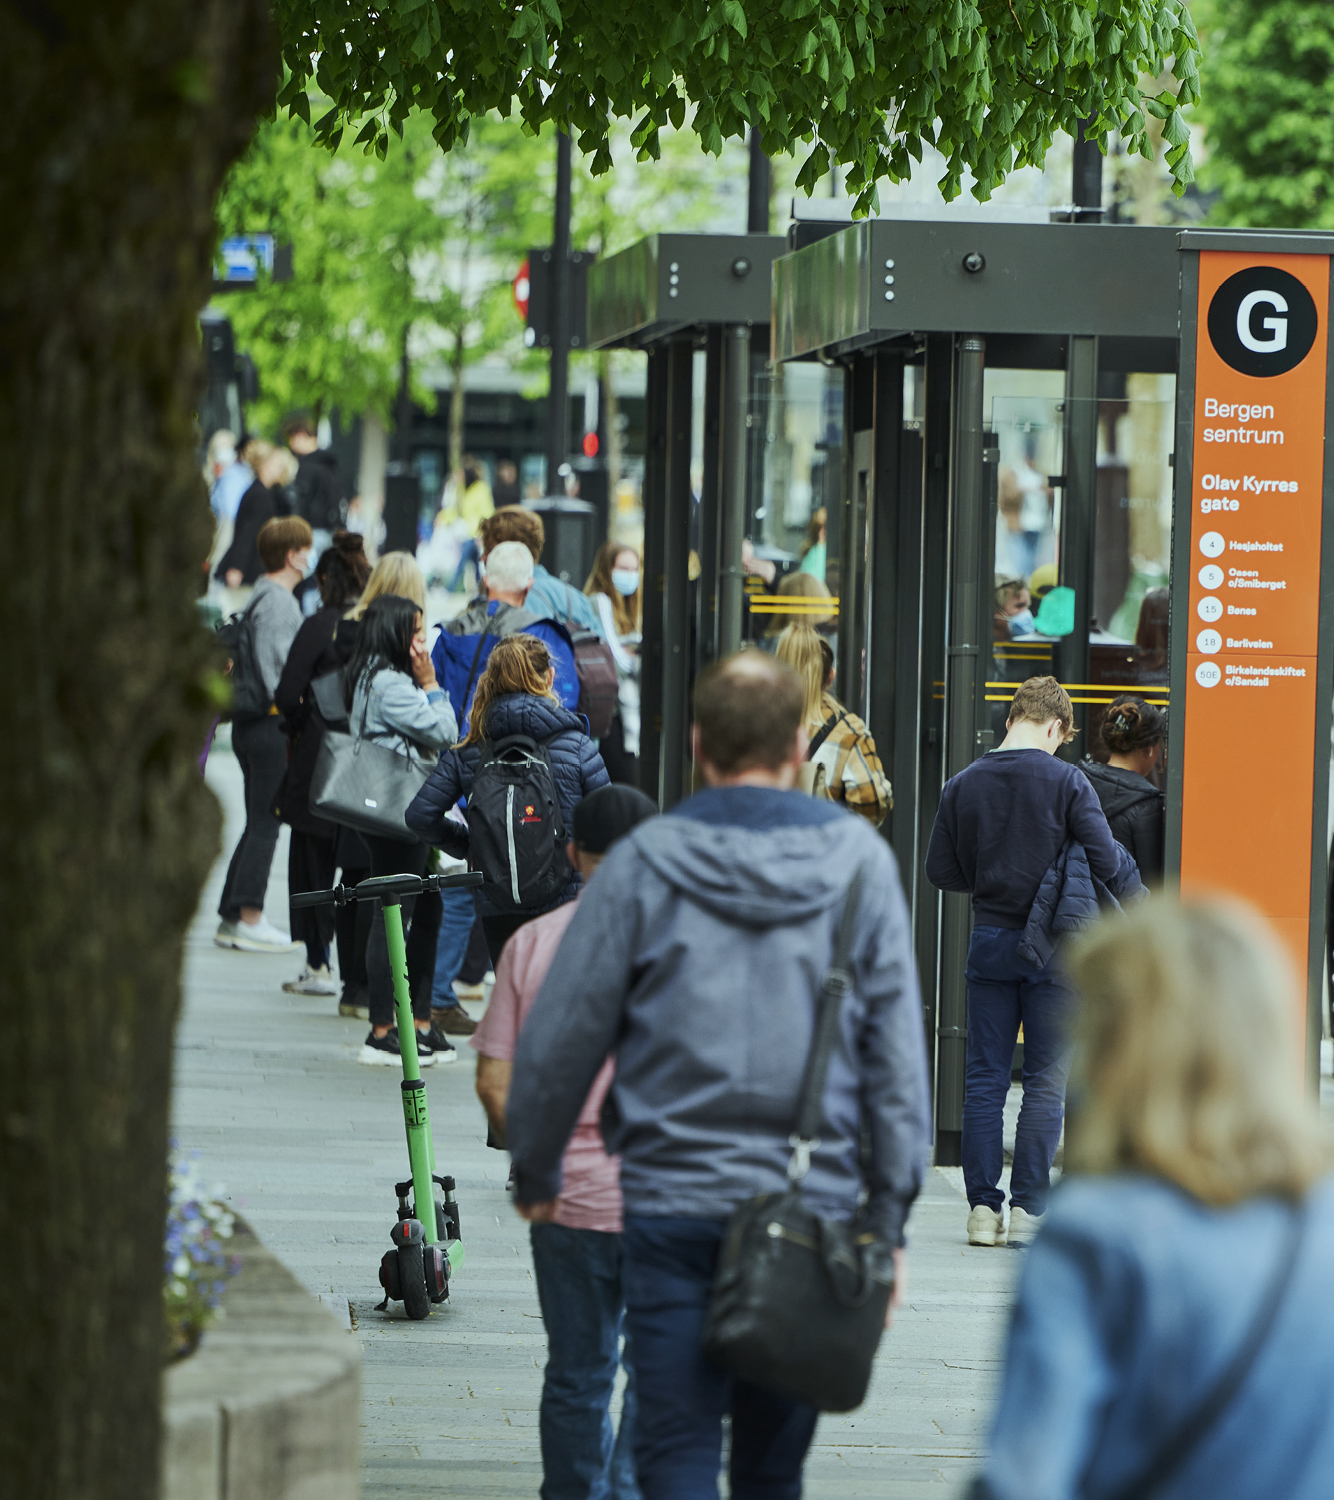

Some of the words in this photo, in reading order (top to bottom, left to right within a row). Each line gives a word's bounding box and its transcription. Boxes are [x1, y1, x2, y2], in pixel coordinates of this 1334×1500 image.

[1236, 289, 1289, 354] G
[1203, 397, 1275, 423] Bergen
[1202, 426, 1285, 445] sentrum
[1200, 473, 1240, 491] Olav
[1242, 474, 1299, 495] Kyrres
[1200, 496, 1240, 514] gate
[1229, 541, 1284, 553] Hesjaholtet
[1228, 567, 1259, 577] Oasen
[1208, 572, 1215, 581] 5
[1227, 578, 1286, 590] o/Smiberget
[1205, 605, 1217, 614] 15
[1204, 638, 1216, 647] 18
[1226, 638, 1274, 650] Barliveien
[1225, 665, 1306, 677] Birkelandsskiftet
[1224, 676, 1270, 687] o/Sandsli
